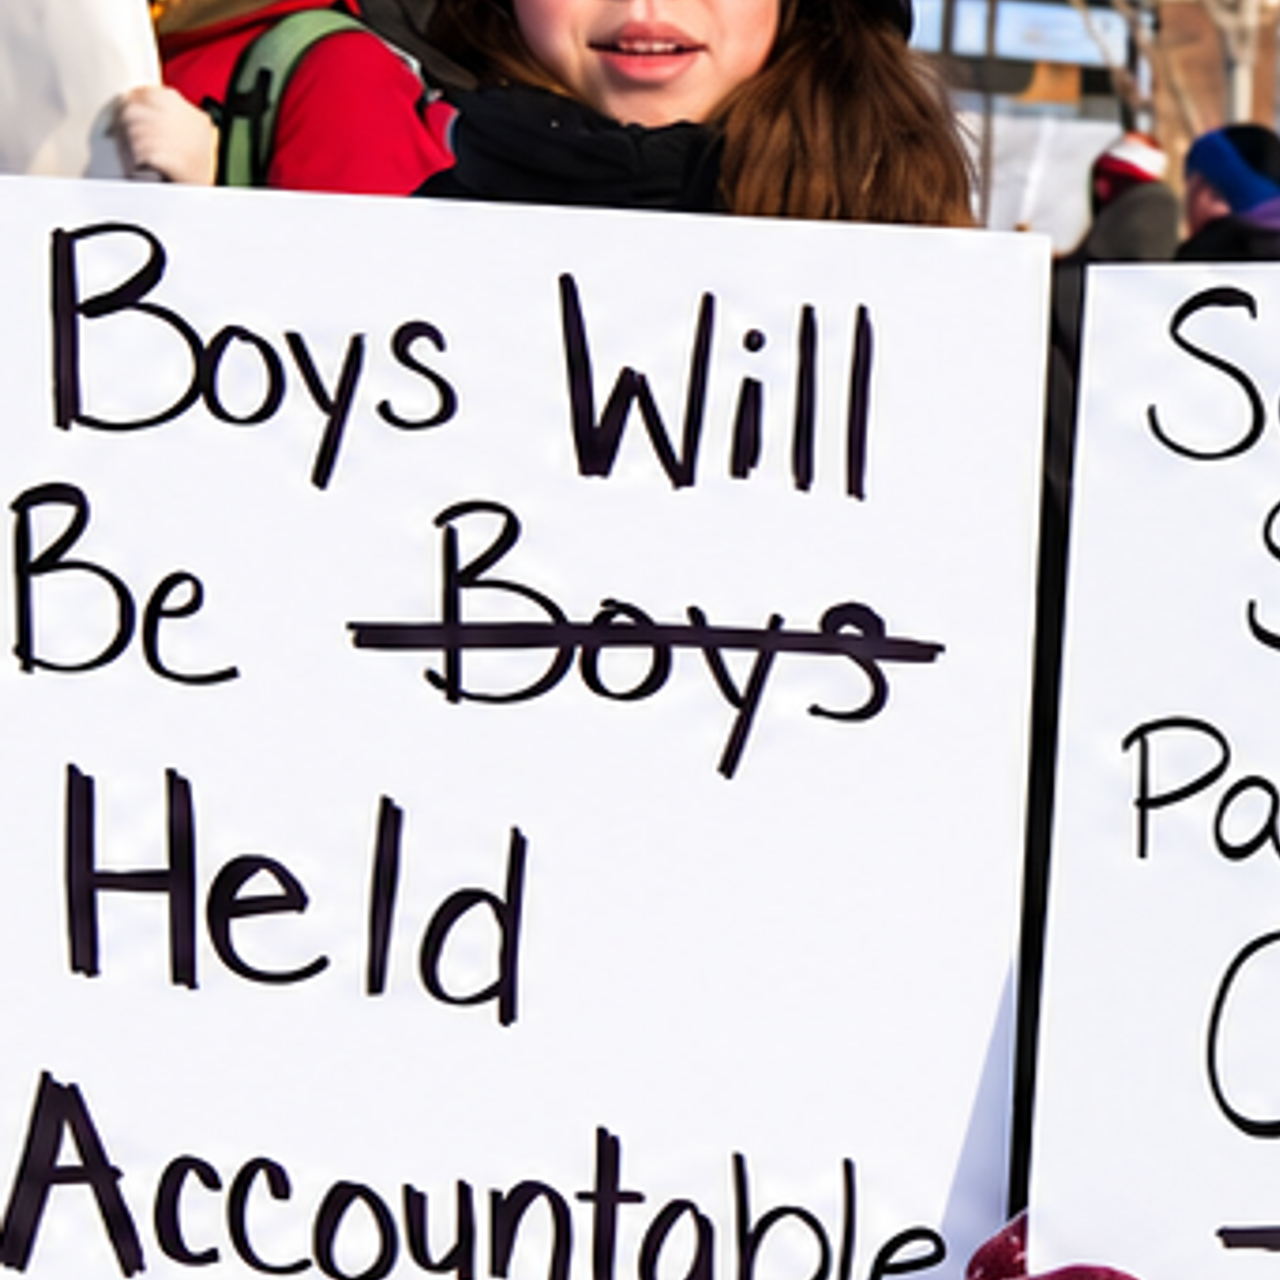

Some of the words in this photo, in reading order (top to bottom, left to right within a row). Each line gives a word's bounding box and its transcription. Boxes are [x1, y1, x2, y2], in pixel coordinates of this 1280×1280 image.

[52, 223, 458, 490] Boys
[559, 274, 872, 500] Will
[11, 483, 240, 685] Be
[426, 500, 889, 779] Boys
[65, 763, 527, 1027] Held
